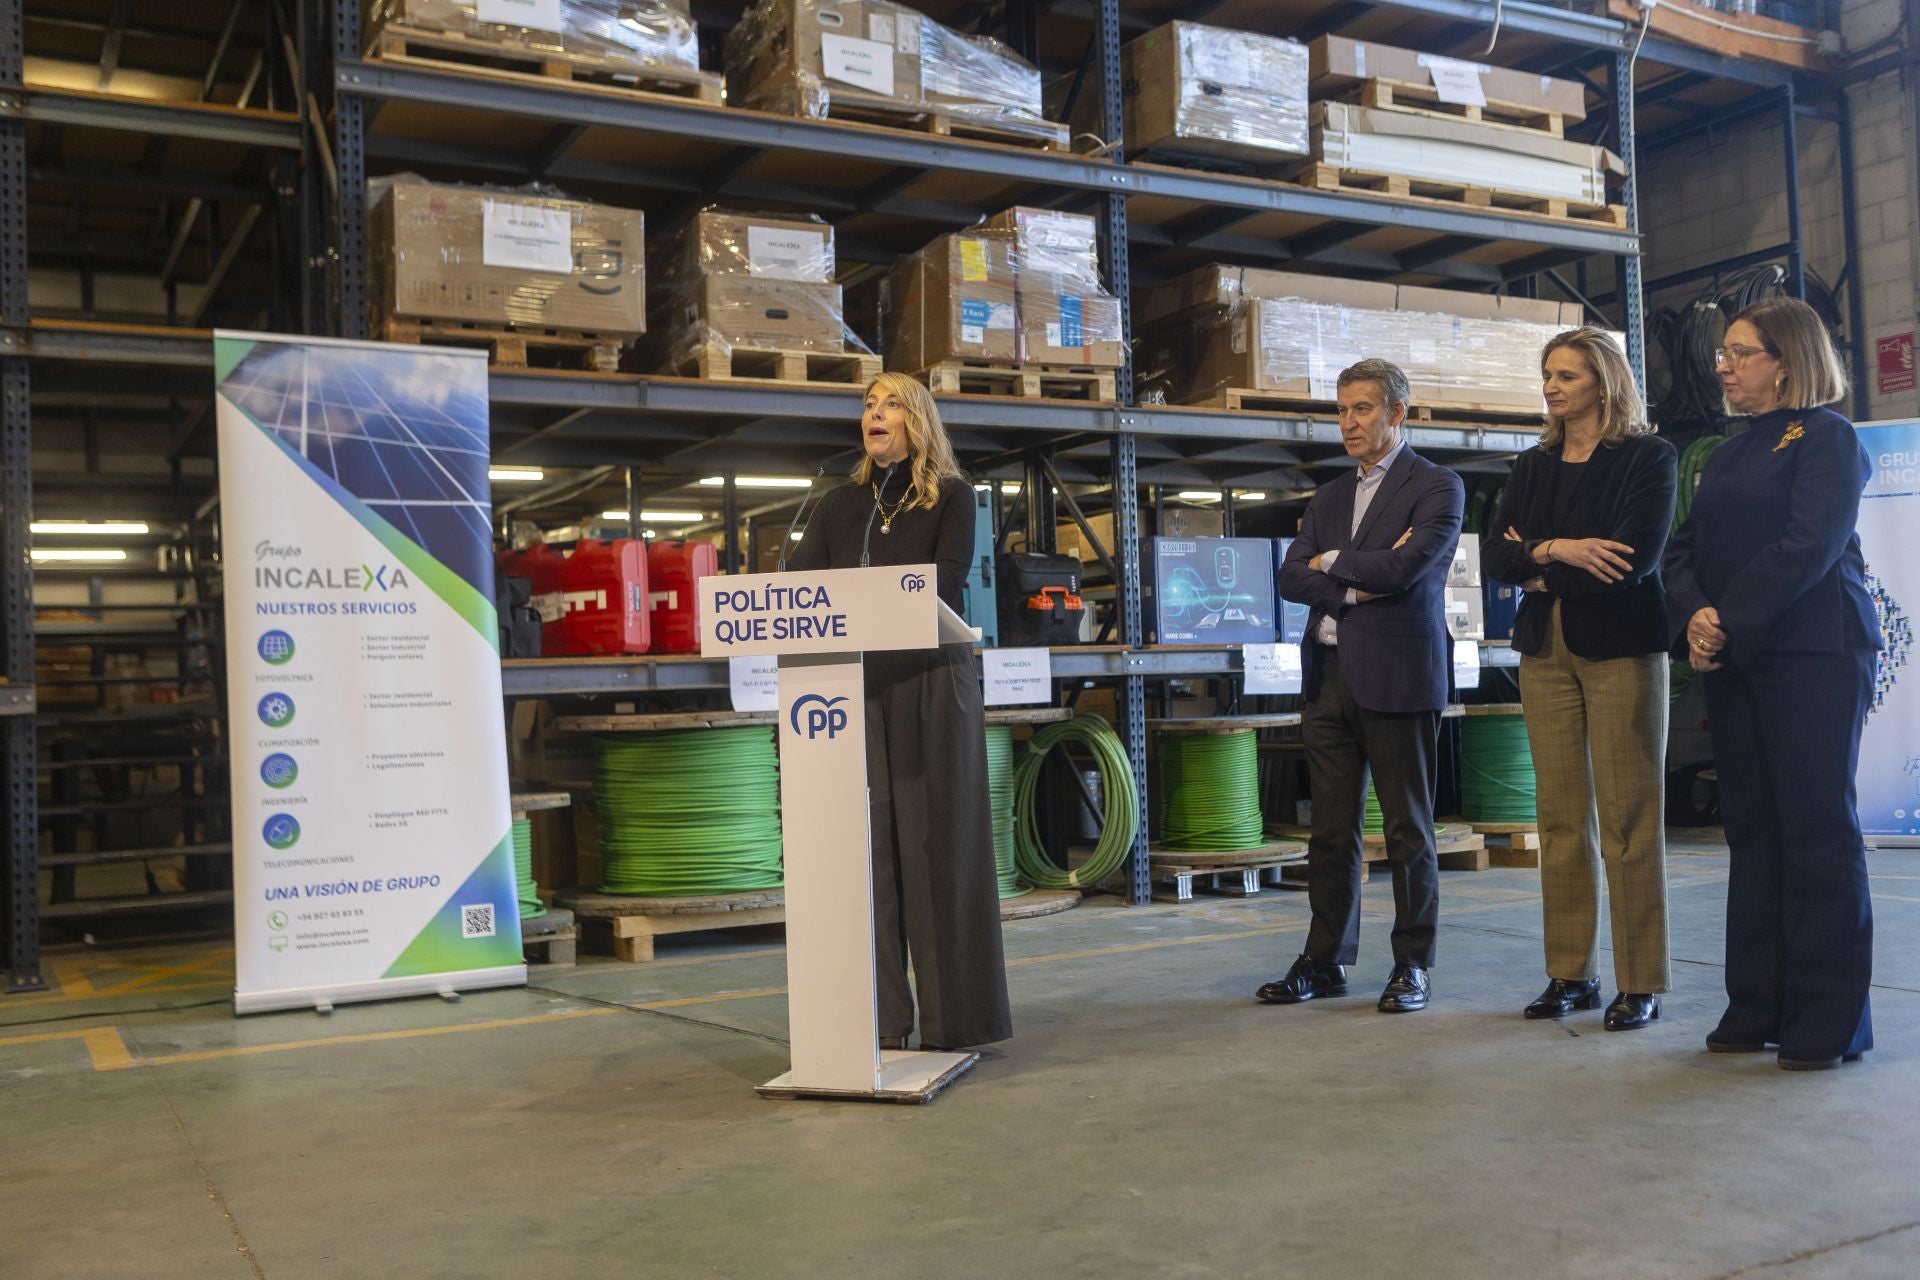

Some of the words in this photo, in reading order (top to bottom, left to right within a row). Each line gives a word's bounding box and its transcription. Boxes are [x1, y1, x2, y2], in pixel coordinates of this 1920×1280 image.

[1879, 452, 1919, 467] GRU
[1880, 468, 1920, 485] INC
[255, 539, 302, 561] Grupo
[255, 565, 409, 592] INCALEXA
[256, 602, 337, 615] NUESTROS
[342, 602, 417, 614] SERVICIOS
[715, 583, 831, 613] POLÍTICA
[715, 618, 768, 645] QUE
[772, 614, 847, 640] SIRVE
[263, 856, 355, 869] TELECOMUNICACIONES
[265, 886, 300, 901] UNA
[304, 879, 359, 898] VISIÓN
[362, 879, 384, 893] DE
[387, 875, 441, 891] GRUPO
